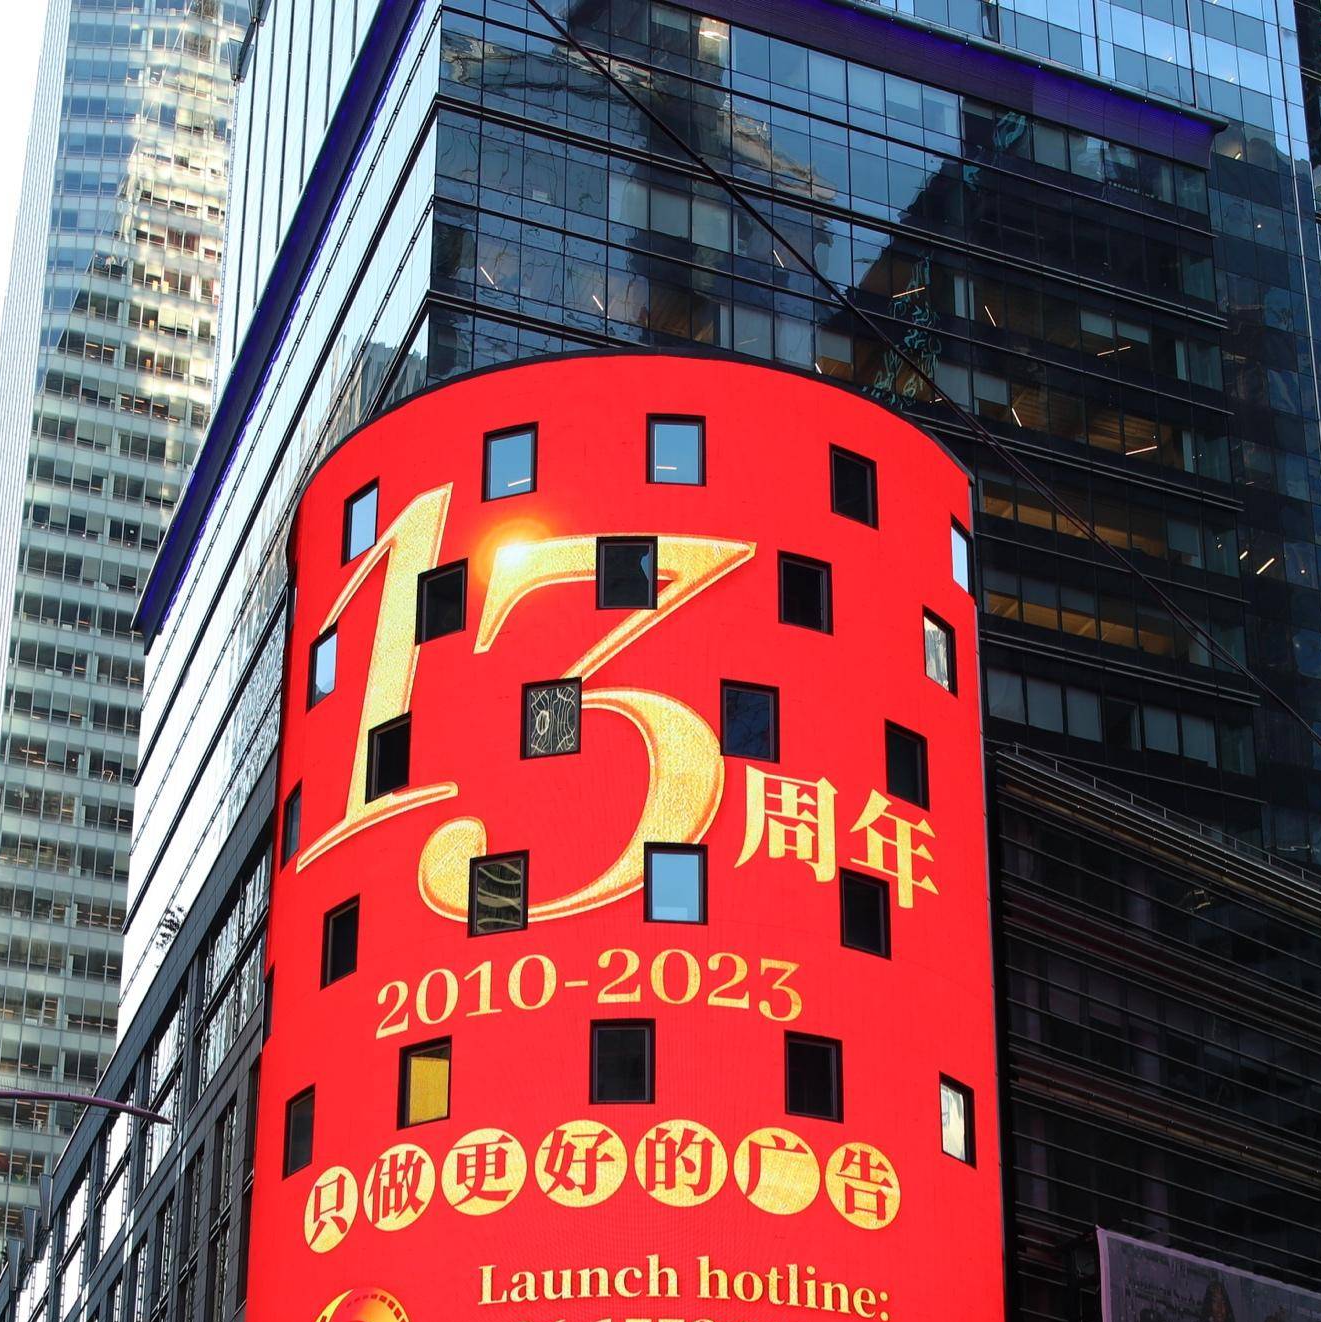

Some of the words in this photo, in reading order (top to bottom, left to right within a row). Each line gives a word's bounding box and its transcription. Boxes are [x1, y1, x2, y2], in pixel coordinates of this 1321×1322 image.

[296, 481, 757, 922] 13
[733, 765, 940, 909] 周年
[376, 947, 804, 1039] 2010-2023
[305, 1121, 900, 1252] 只做更好的广告
[477, 1255, 681, 1307] Launch
[697, 1255, 890, 1322] hotline:
